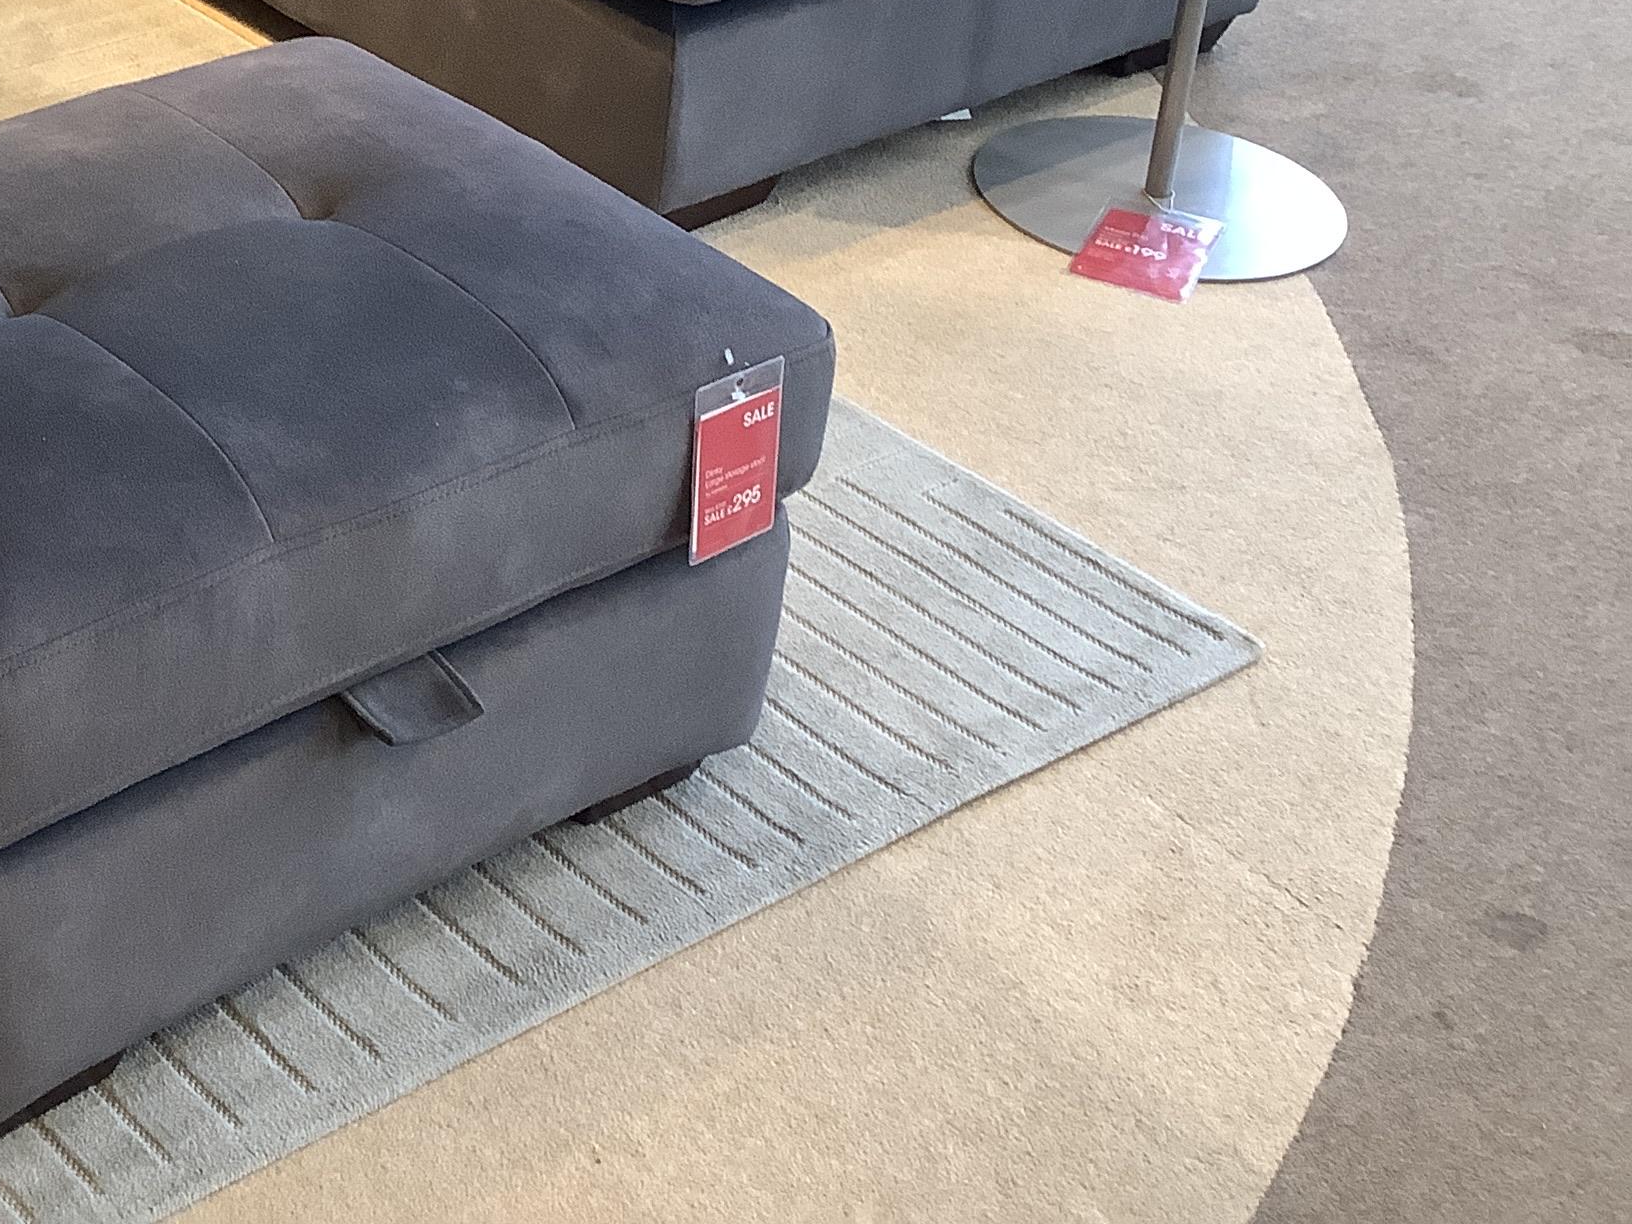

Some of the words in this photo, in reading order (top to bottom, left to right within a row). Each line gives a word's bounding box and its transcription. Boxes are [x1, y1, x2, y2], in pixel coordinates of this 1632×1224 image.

[1160, 222, 1198, 239] SAL
[1095, 239, 1122, 250] SALE
[743, 401, 775, 427] SALE
[704, 508, 725, 525] SALE
[727, 484, 761, 515] £295
